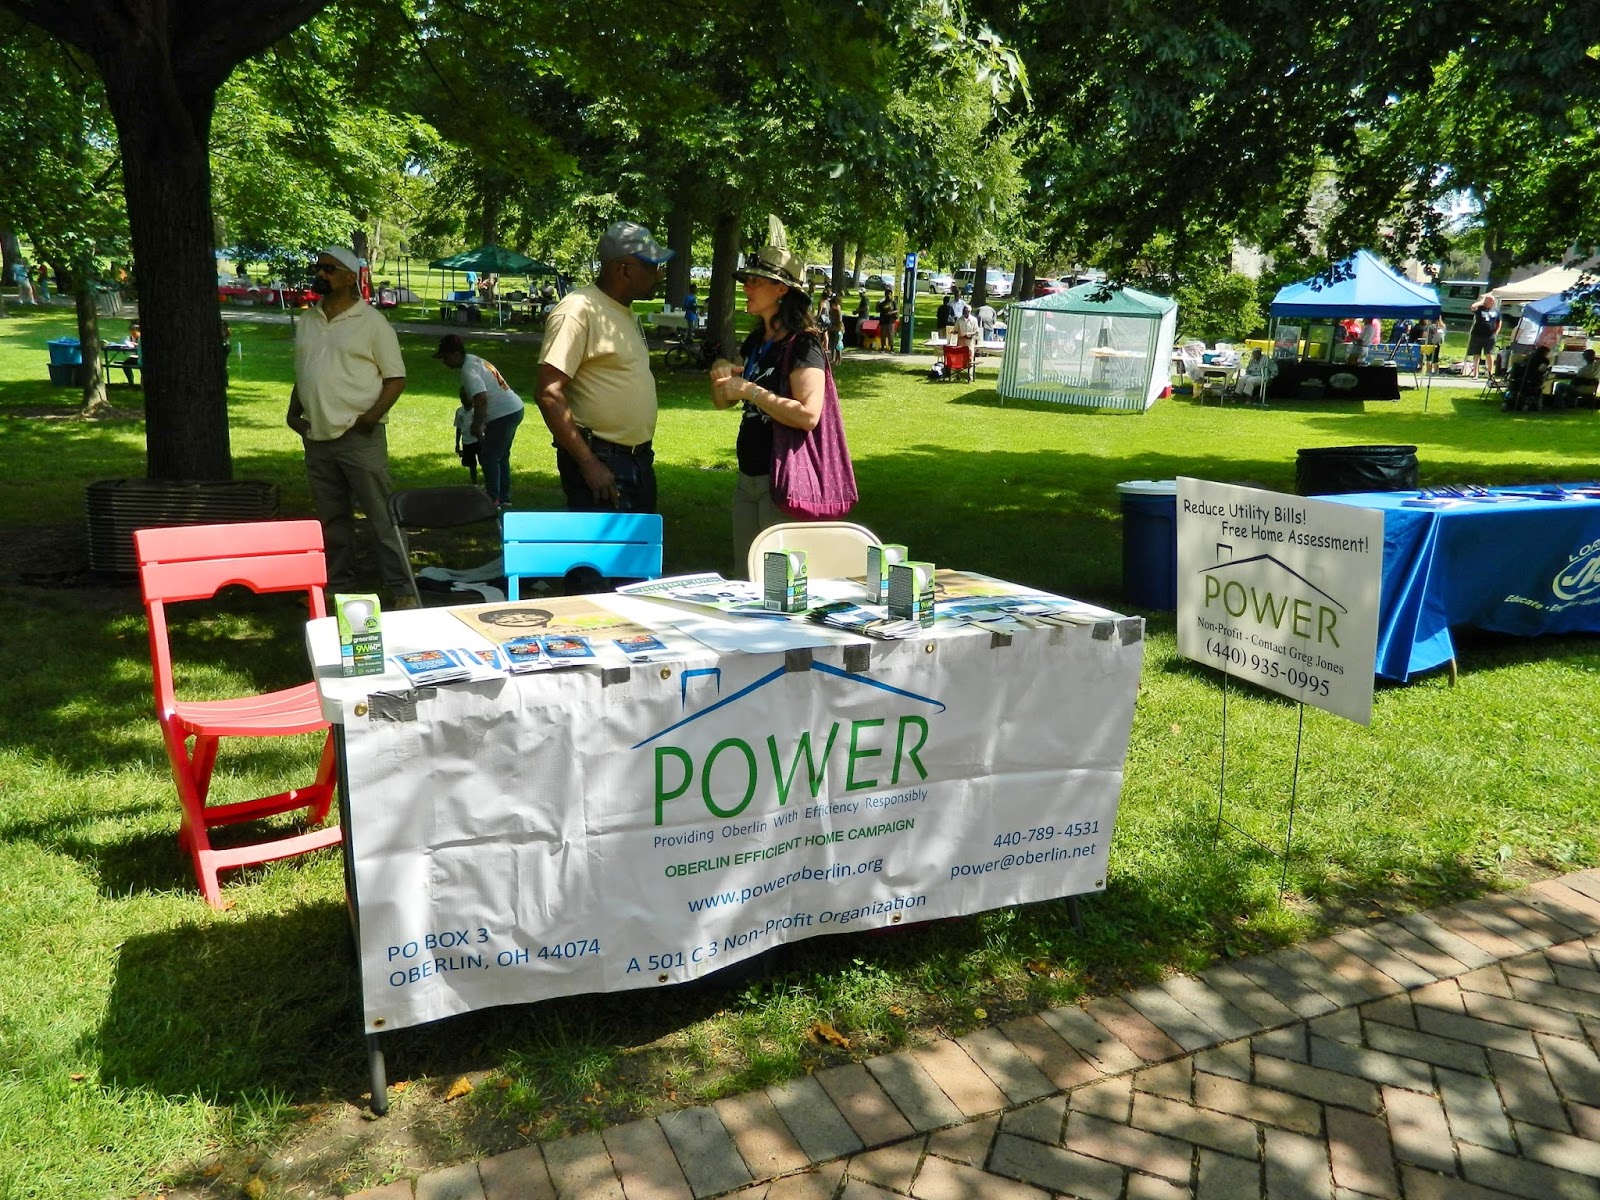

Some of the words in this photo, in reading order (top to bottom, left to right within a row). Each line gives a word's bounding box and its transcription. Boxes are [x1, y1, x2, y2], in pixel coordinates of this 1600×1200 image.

[1184, 499, 1225, 516] Reduce
[1229, 503, 1270, 525] Utility
[1274, 506, 1306, 525] Bills!
[1221, 521, 1248, 538] Free
[1251, 525, 1283, 543] Home
[1288, 532, 1369, 553] Assessment!
[1205, 574, 1340, 648] POWER
[1197, 616, 1243, 641] Non-Profit
[1251, 634, 1286, 656] Contact
[1289, 646, 1313, 668] Greg
[1315, 653, 1344, 675] Jones
[1206, 637, 1247, 668] (440)
[1251, 654, 1330, 697] 935-0995
[654, 715, 930, 825] POWER
[654, 830, 714, 848] Providing
[722, 822, 767, 838] Oberlin
[773, 810, 798, 828] With
[805, 801, 860, 819] Efficiency
[865, 788, 928, 809] Responsibly
[665, 855, 730, 877] OBERLIN
[734, 837, 802, 865] EFFICIENT
[805, 831, 844, 846] HOME
[848, 818, 915, 840] CAMPAIGN
[688, 858, 884, 912] www.poweroberlin.org
[950, 843, 1096, 880] power@oberlin.net
[388, 942, 418, 962] PO
[425, 930, 469, 950] BOX
[477, 928, 489, 944] 3
[389, 954, 490, 987] OBERLIN,
[497, 947, 529, 967] OH
[537, 938, 601, 960] 44074
[626, 957, 641, 974] A
[648, 952, 684, 970] 501
[691, 947, 703, 963] C
[708, 941, 718, 957] 3
[724, 913, 813, 951] Non-Profit
[819, 895, 926, 924] Organization
